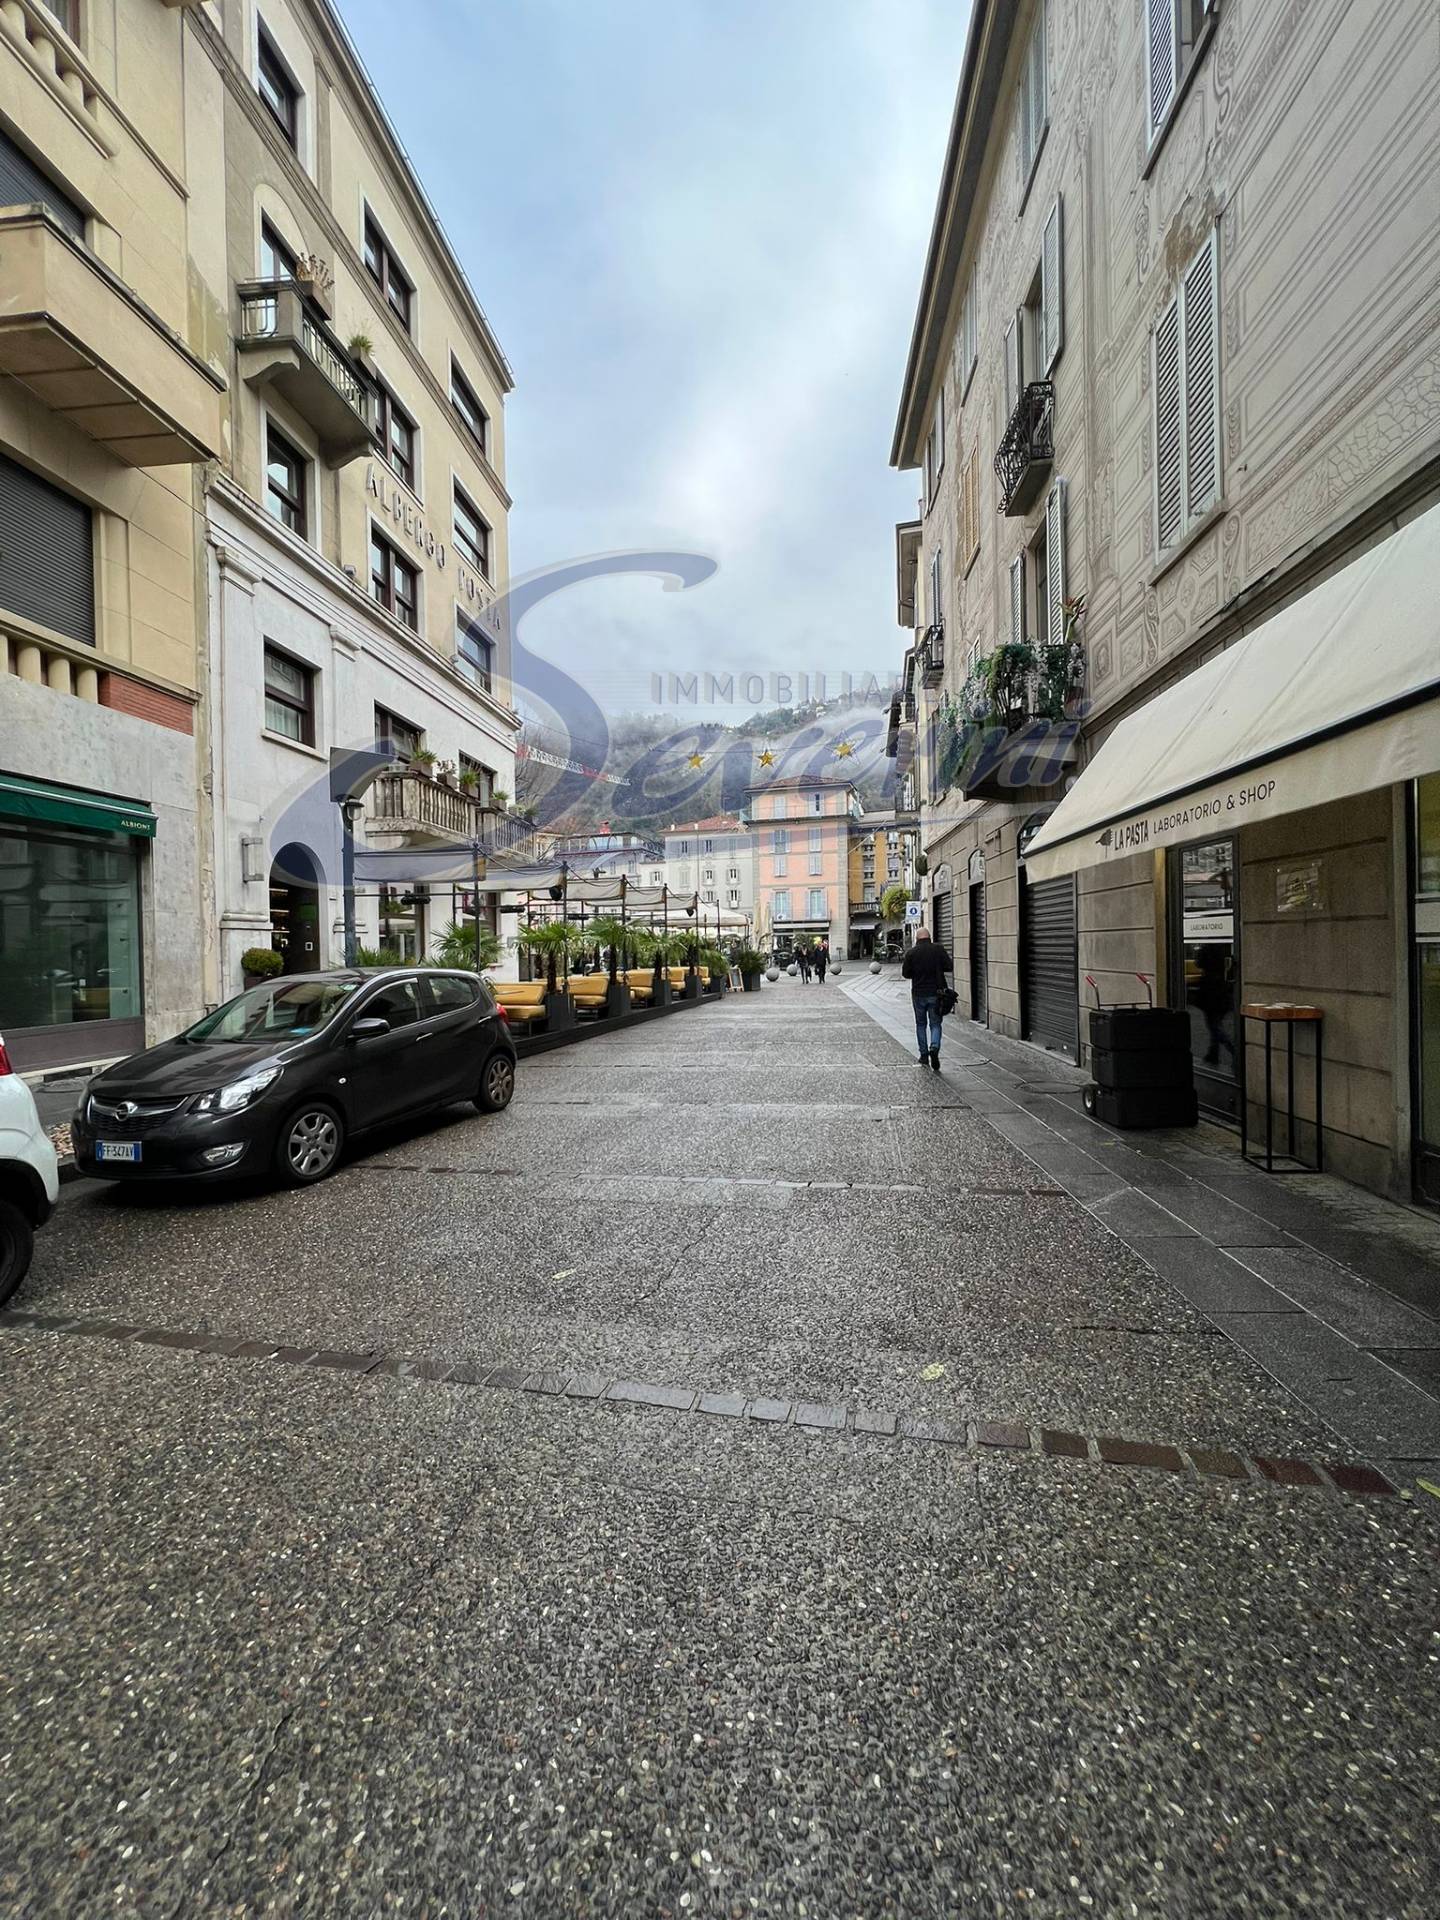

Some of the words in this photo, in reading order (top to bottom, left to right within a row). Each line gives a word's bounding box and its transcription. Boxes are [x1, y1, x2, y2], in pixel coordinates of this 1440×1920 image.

[366, 463, 445, 569] ALBERGO
[458, 566, 500, 630] POSTA
[1114, 829, 1124, 851] LA
[1125, 820, 1149, 848] PASTA
[1153, 799, 1221, 835] LABORATORIO
[1226, 794, 1235, 810] &
[1239, 780, 1276, 806] SHOP
